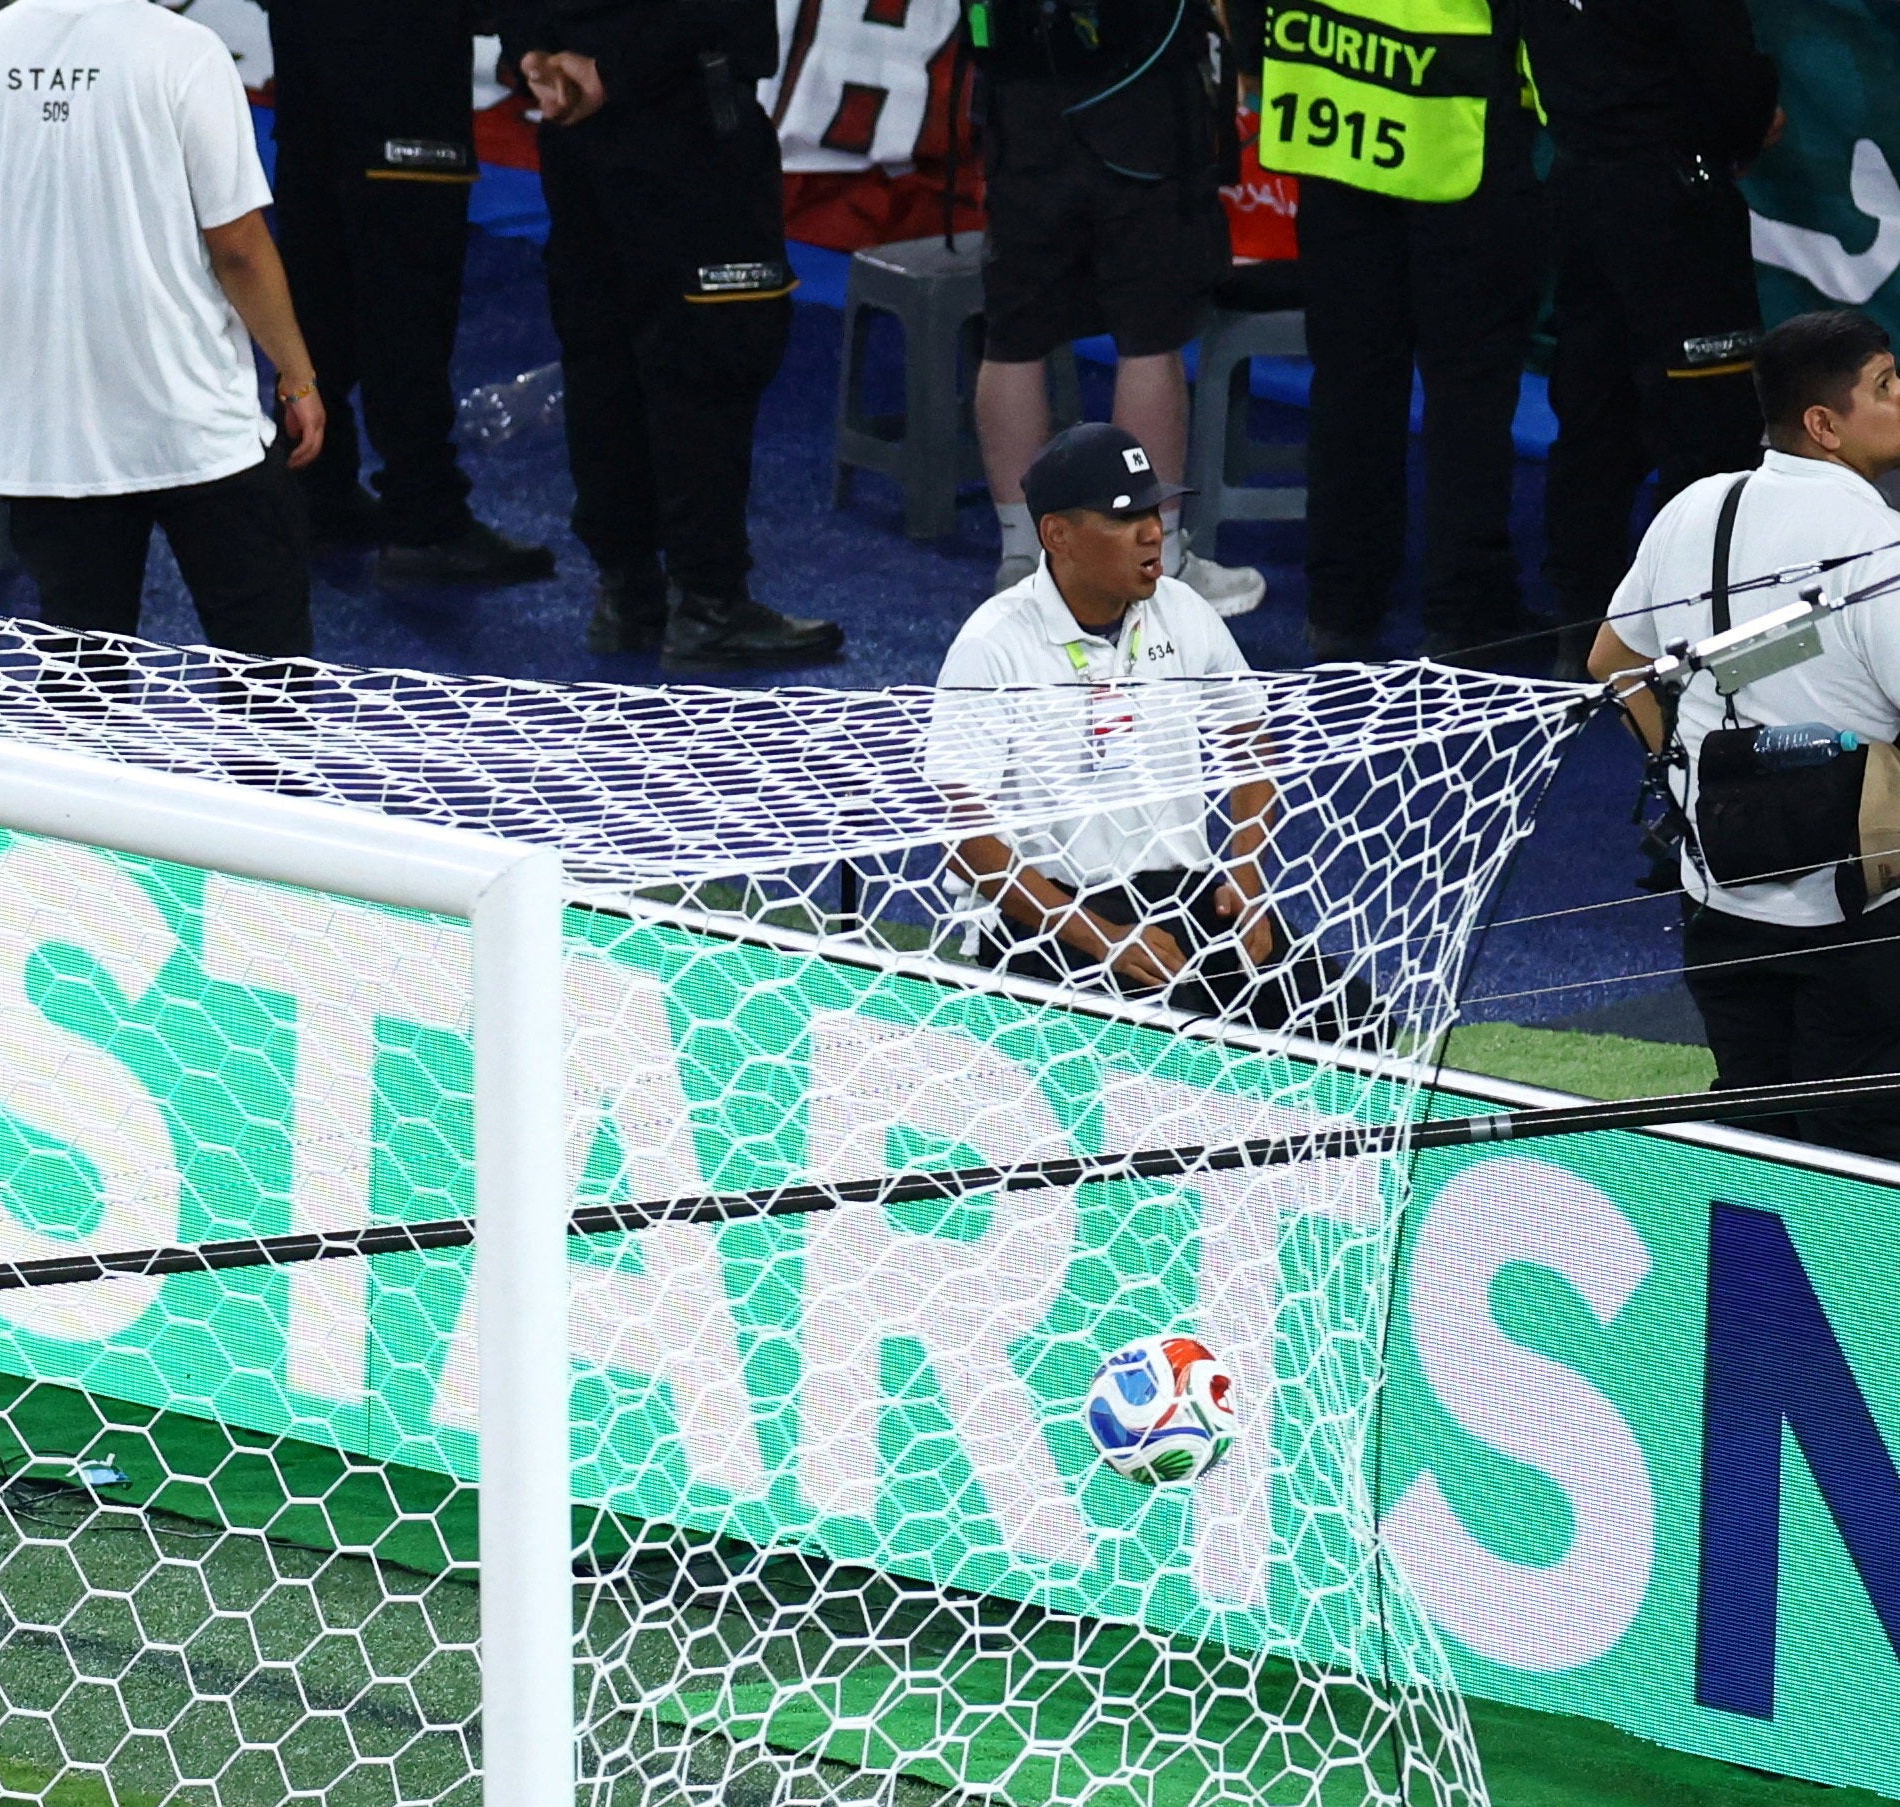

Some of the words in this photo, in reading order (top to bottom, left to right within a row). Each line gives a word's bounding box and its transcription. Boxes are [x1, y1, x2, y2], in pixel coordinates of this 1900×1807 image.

[7, 67, 101, 91] STAFF
[42, 101, 70, 122] 509
[1271, 92, 1407, 169] 1915
[1148, 640, 1175, 661] 534
